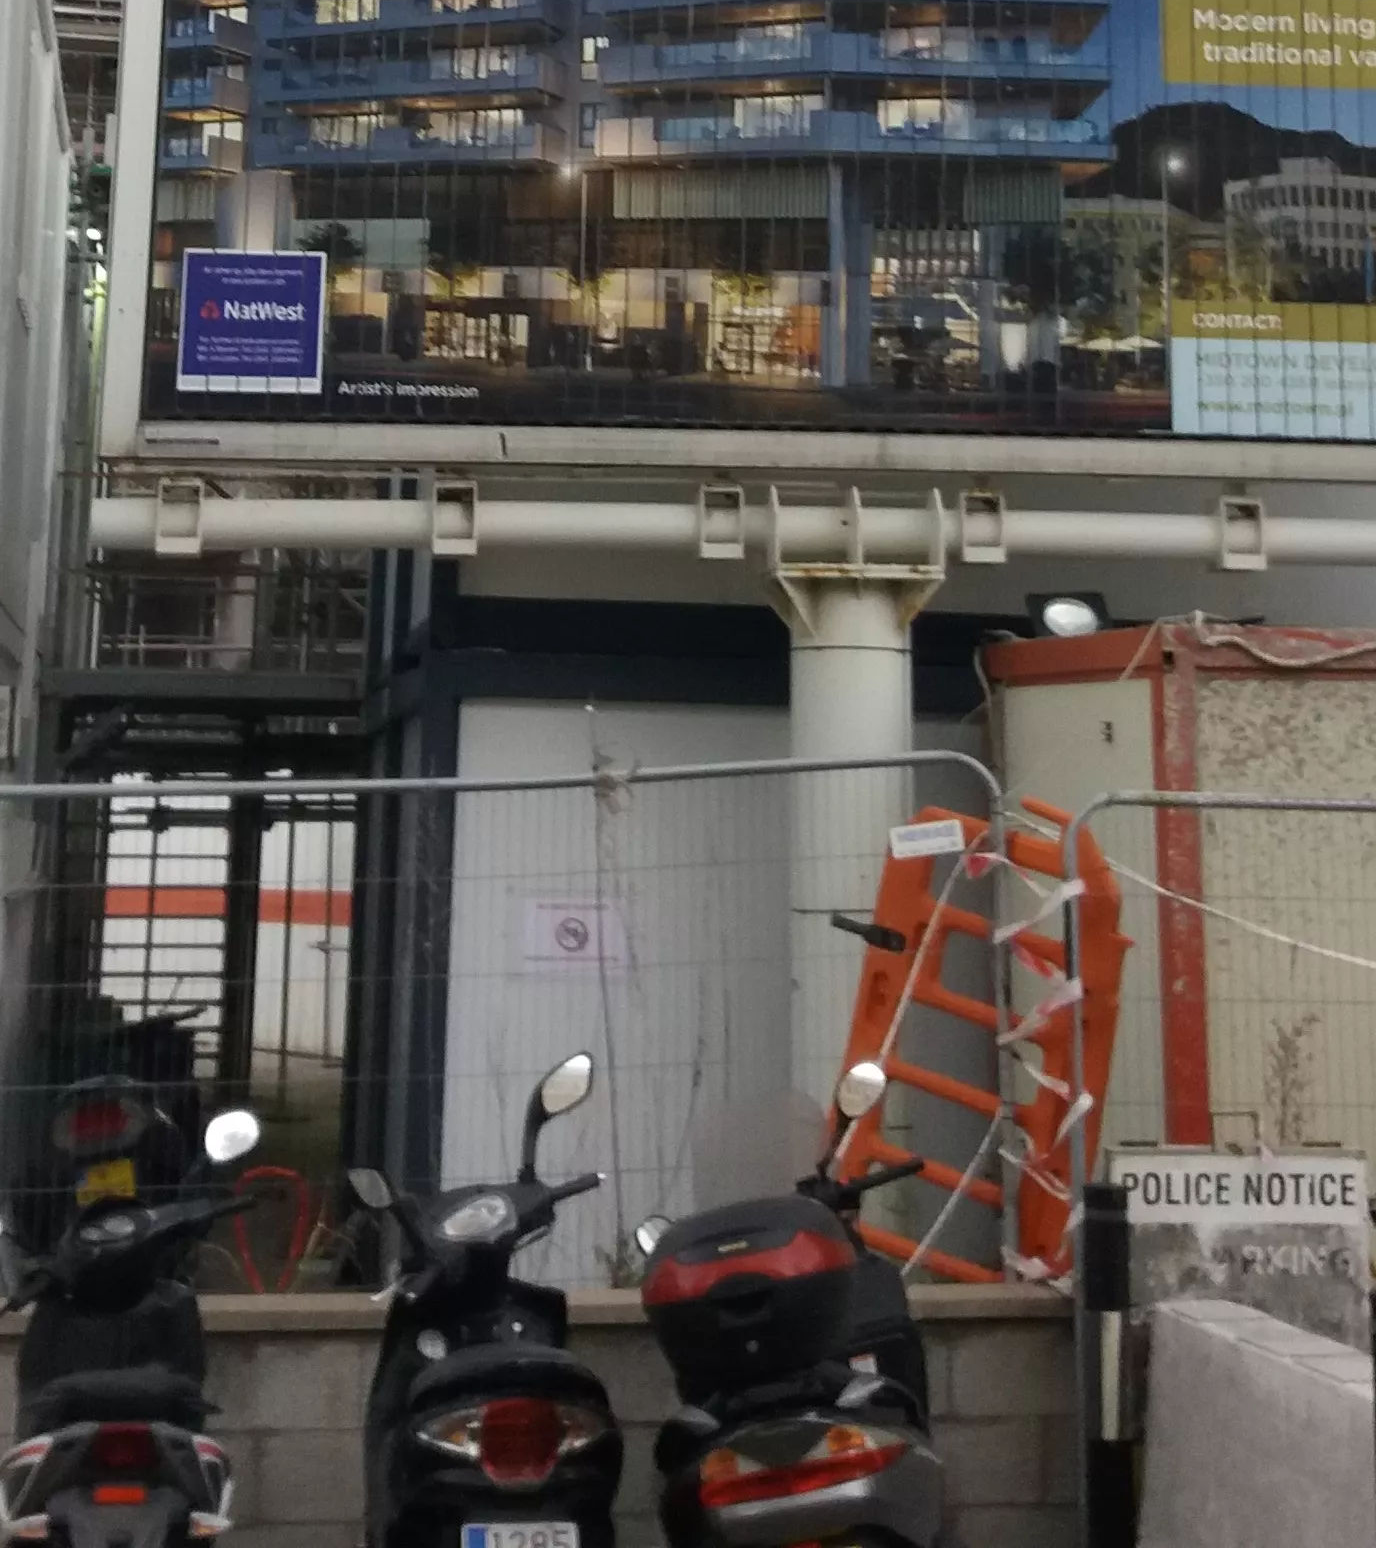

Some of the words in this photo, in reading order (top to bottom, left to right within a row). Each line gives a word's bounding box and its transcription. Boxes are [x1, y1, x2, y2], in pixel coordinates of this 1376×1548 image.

[1303, 10, 1376, 40] living
[1201, 39, 1342, 67] traditional
[224, 300, 305, 321] NatWest
[1197, 352, 1298, 371] MIDTOWN
[338, 380, 394, 396] Artist's
[397, 381, 480, 398] impression
[1123, 1172, 1231, 1206] POLICE
[1243, 1173, 1356, 1206] NOTICE
